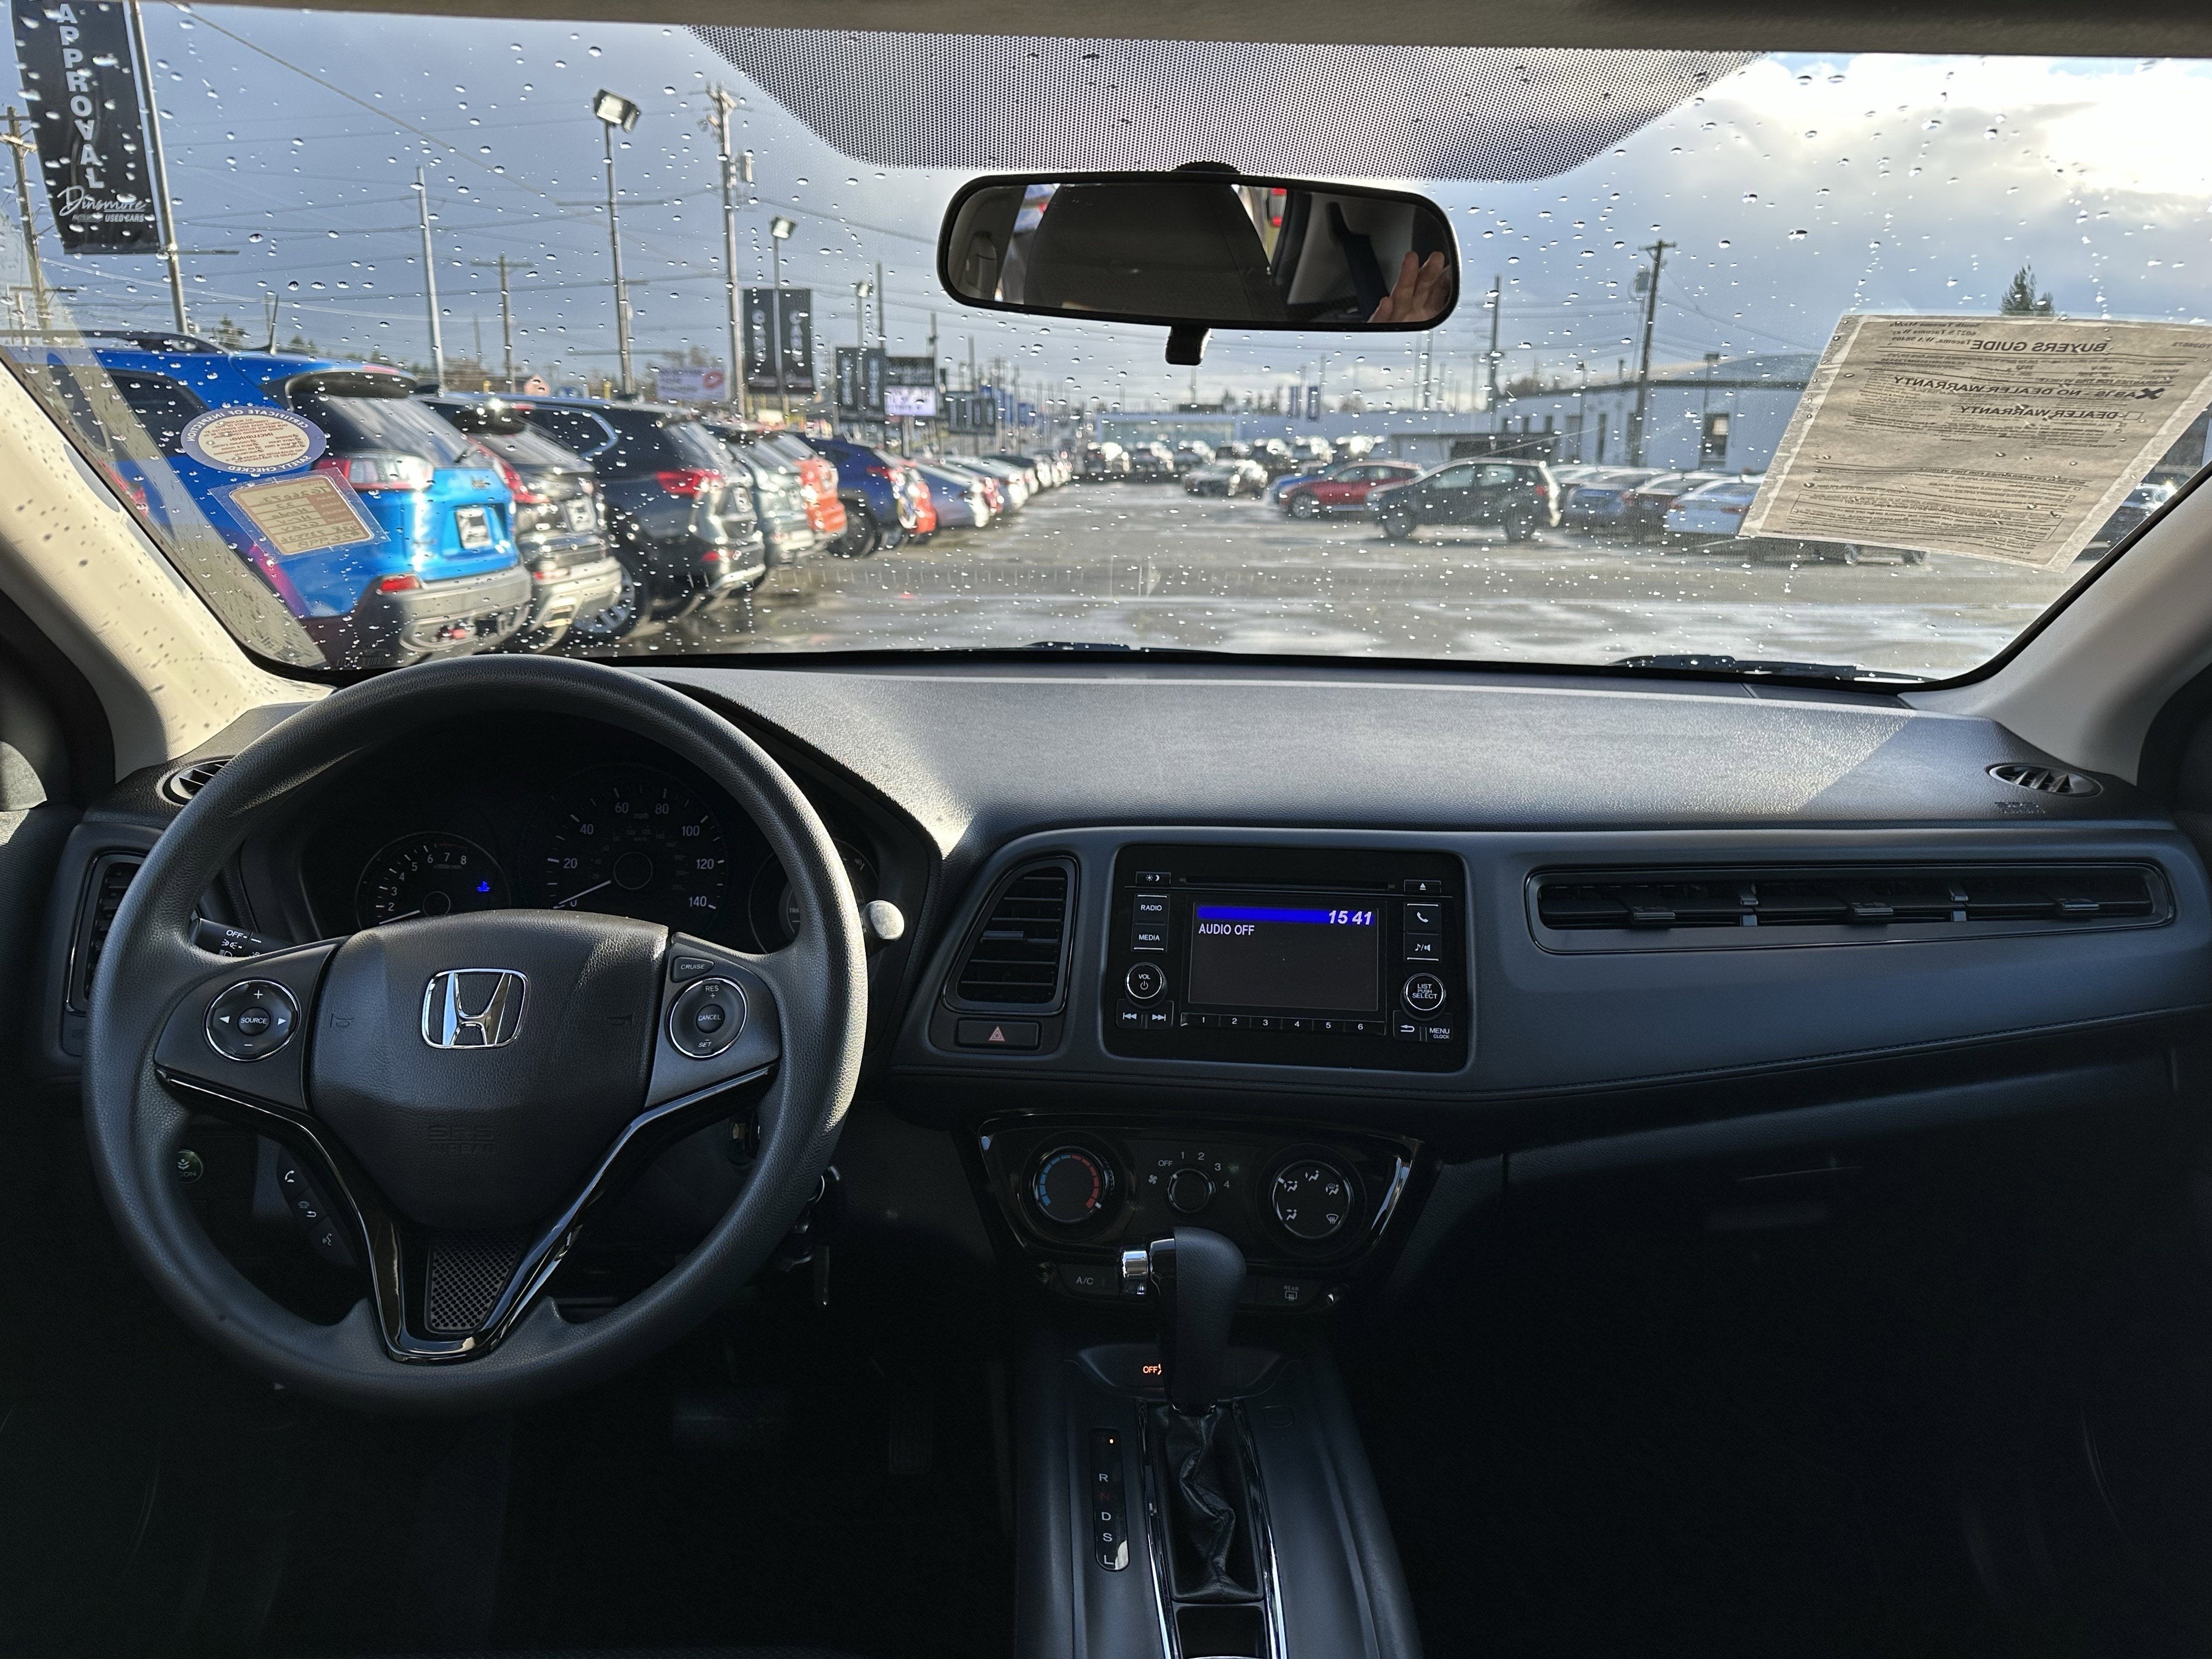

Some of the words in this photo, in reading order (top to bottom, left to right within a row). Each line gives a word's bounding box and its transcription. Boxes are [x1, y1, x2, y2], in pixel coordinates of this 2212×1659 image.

[57, 3, 105, 189] APPROVAL
[105, 213, 123, 222] USED
[614, 802, 629, 814] 60
[654, 803, 669, 814] 80
[579, 823, 594, 835] 40
[681, 825, 700, 837] 100
[427, 854, 433, 864] 6
[444, 852, 450, 862] 7
[460, 855, 466, 865] 8
[411, 862, 417, 872] 5
[563, 857, 578, 870] 20
[696, 858, 714, 870] 120
[398, 872, 405, 881] 4
[391, 887, 398, 896] 3
[689, 895, 707, 907] 140
[388, 902, 394, 911] 2
[226, 930, 244, 939] OFF
[1198, 923, 1231, 935] AUDIO
[1234, 924, 1255, 936] OFF
[1181, 1151, 1185, 1159] 1
[1198, 1152, 1205, 1160] 2
[1214, 1162, 1221, 1171] 3
[1223, 1180, 1230, 1188] 4
[1076, 1276, 1094, 1285] A/C
[1143, 1365, 1158, 1374] OFF
[1099, 1474, 1109, 1482] R
[1102, 1511, 1111, 1521] D
[1103, 1532, 1113, 1542] S
[1104, 1554, 1114, 1565] L
